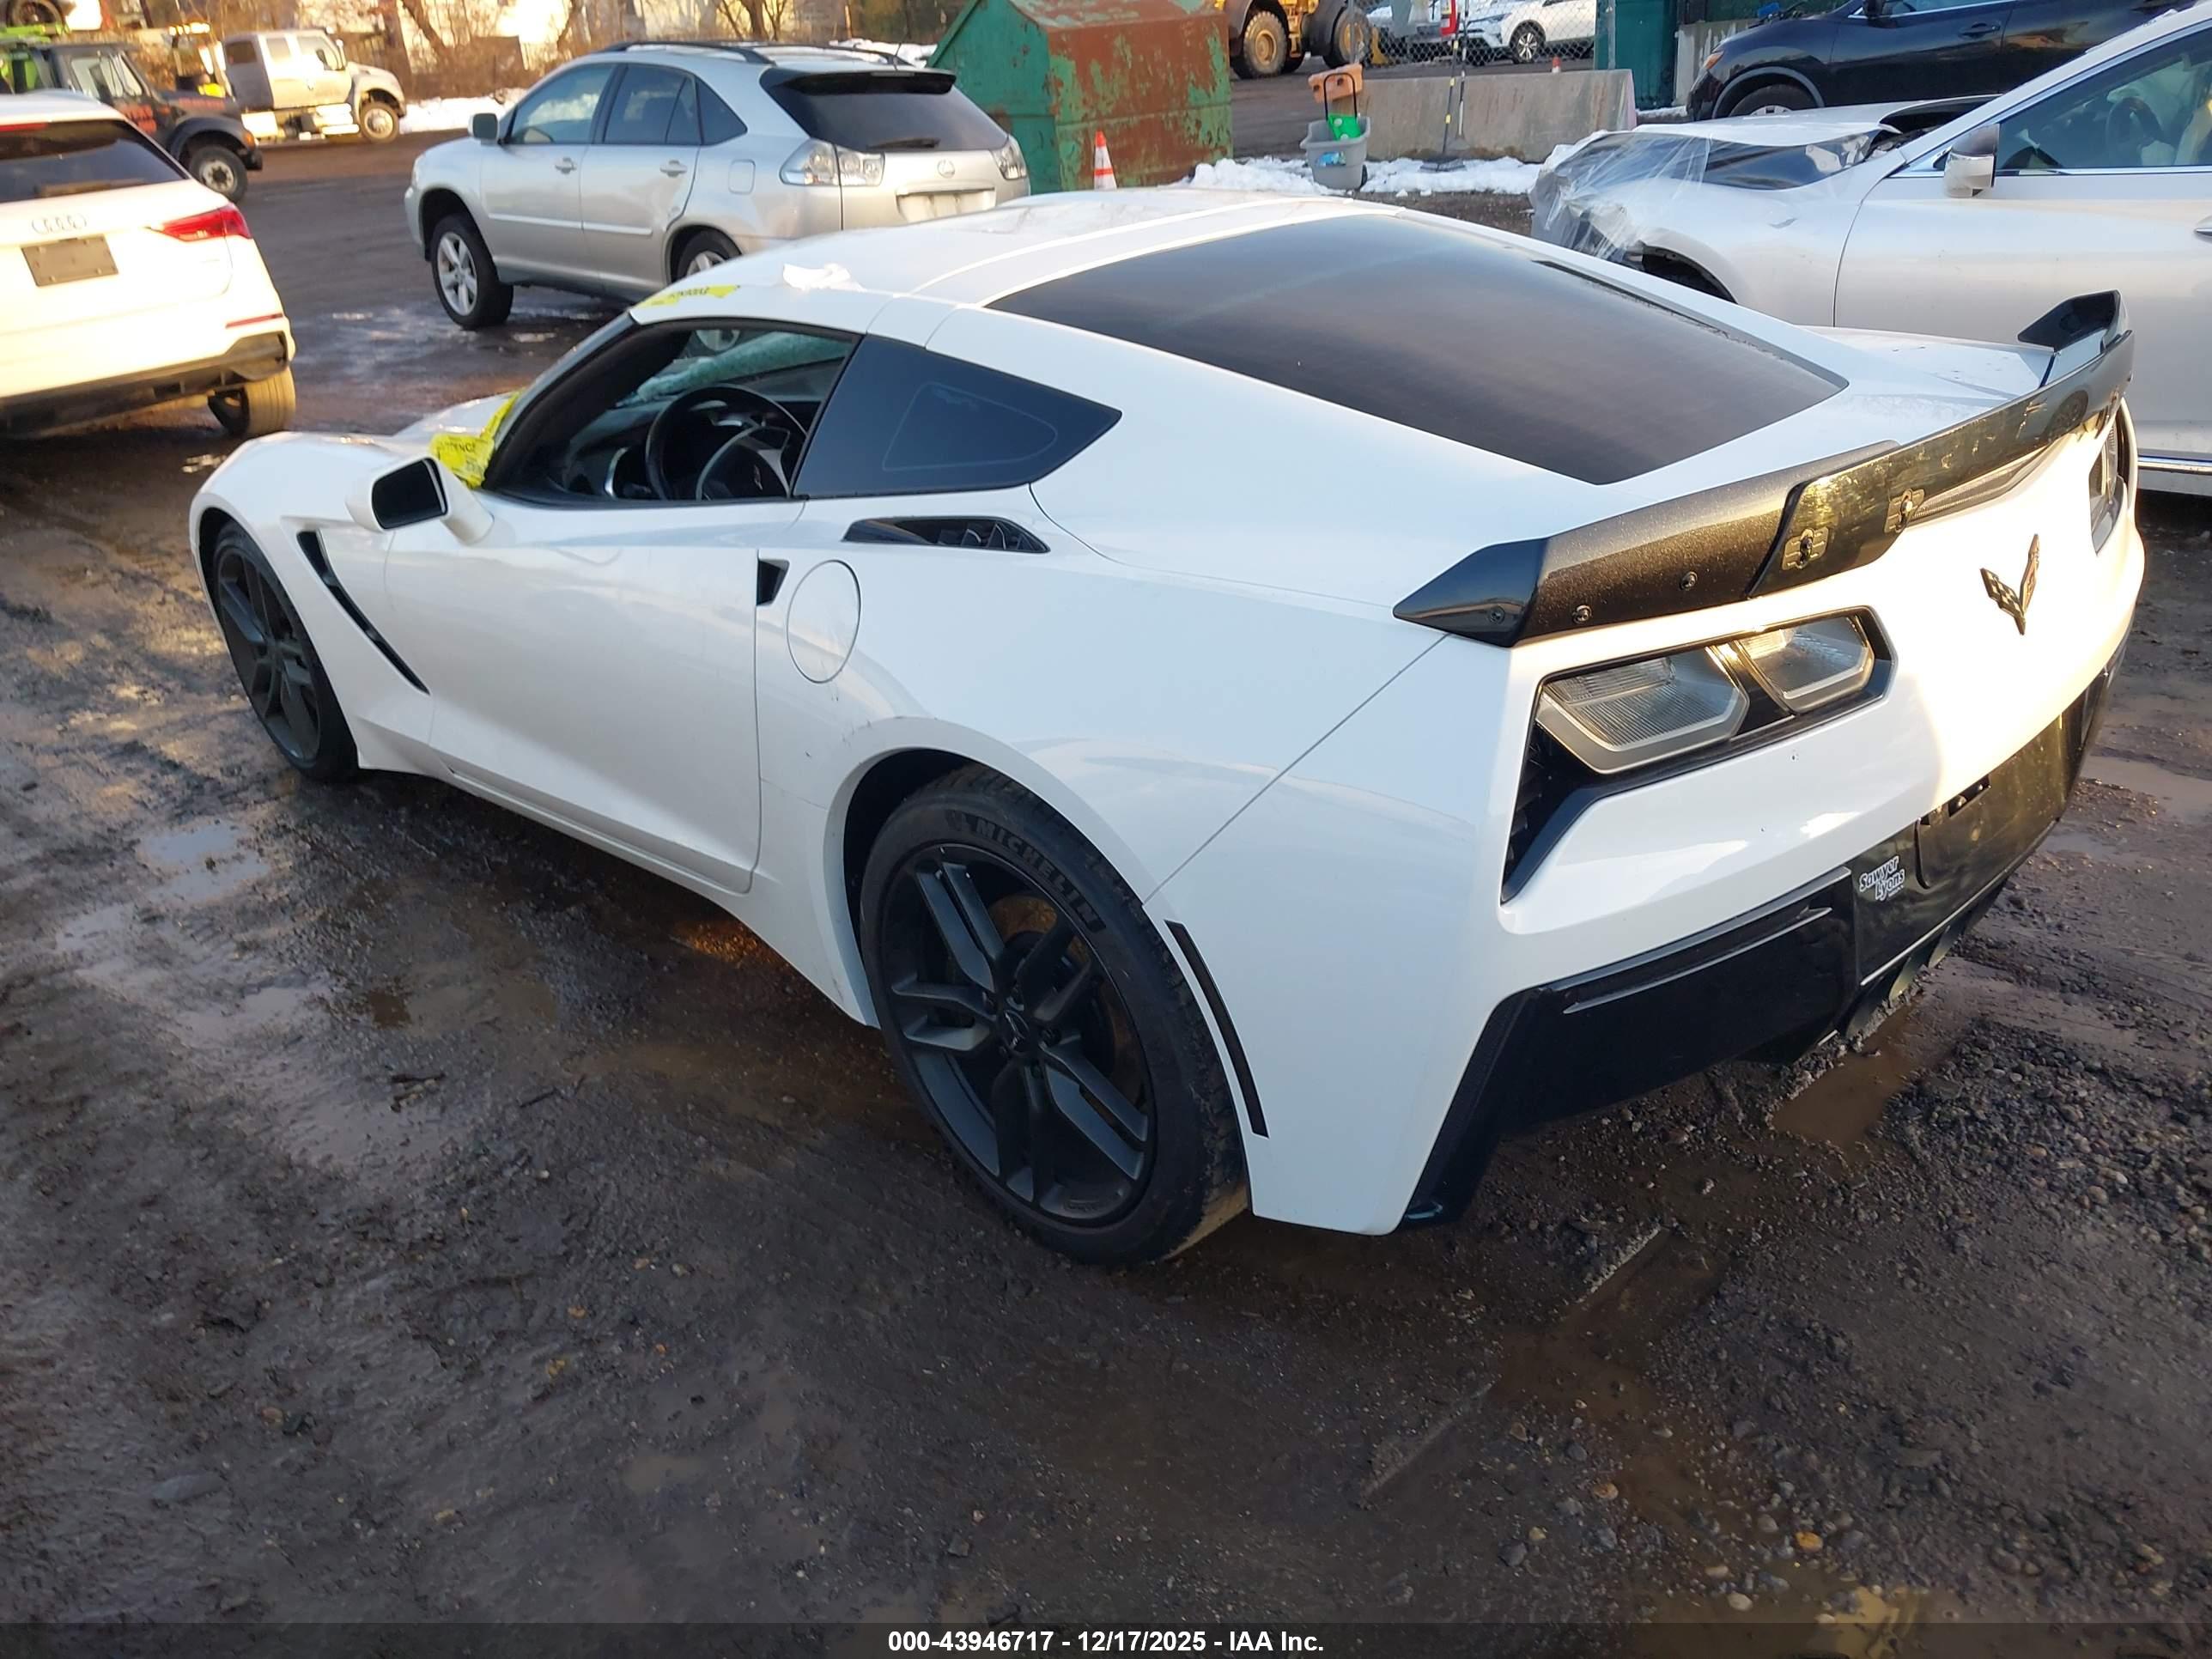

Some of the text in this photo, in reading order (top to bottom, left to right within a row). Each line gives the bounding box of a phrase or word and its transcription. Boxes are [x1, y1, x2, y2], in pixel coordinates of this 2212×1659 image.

[975, 817, 1103, 929] MICHELIN
[1859, 855, 1899, 891] Sawyer
[1875, 868, 1905, 901] Lyons
